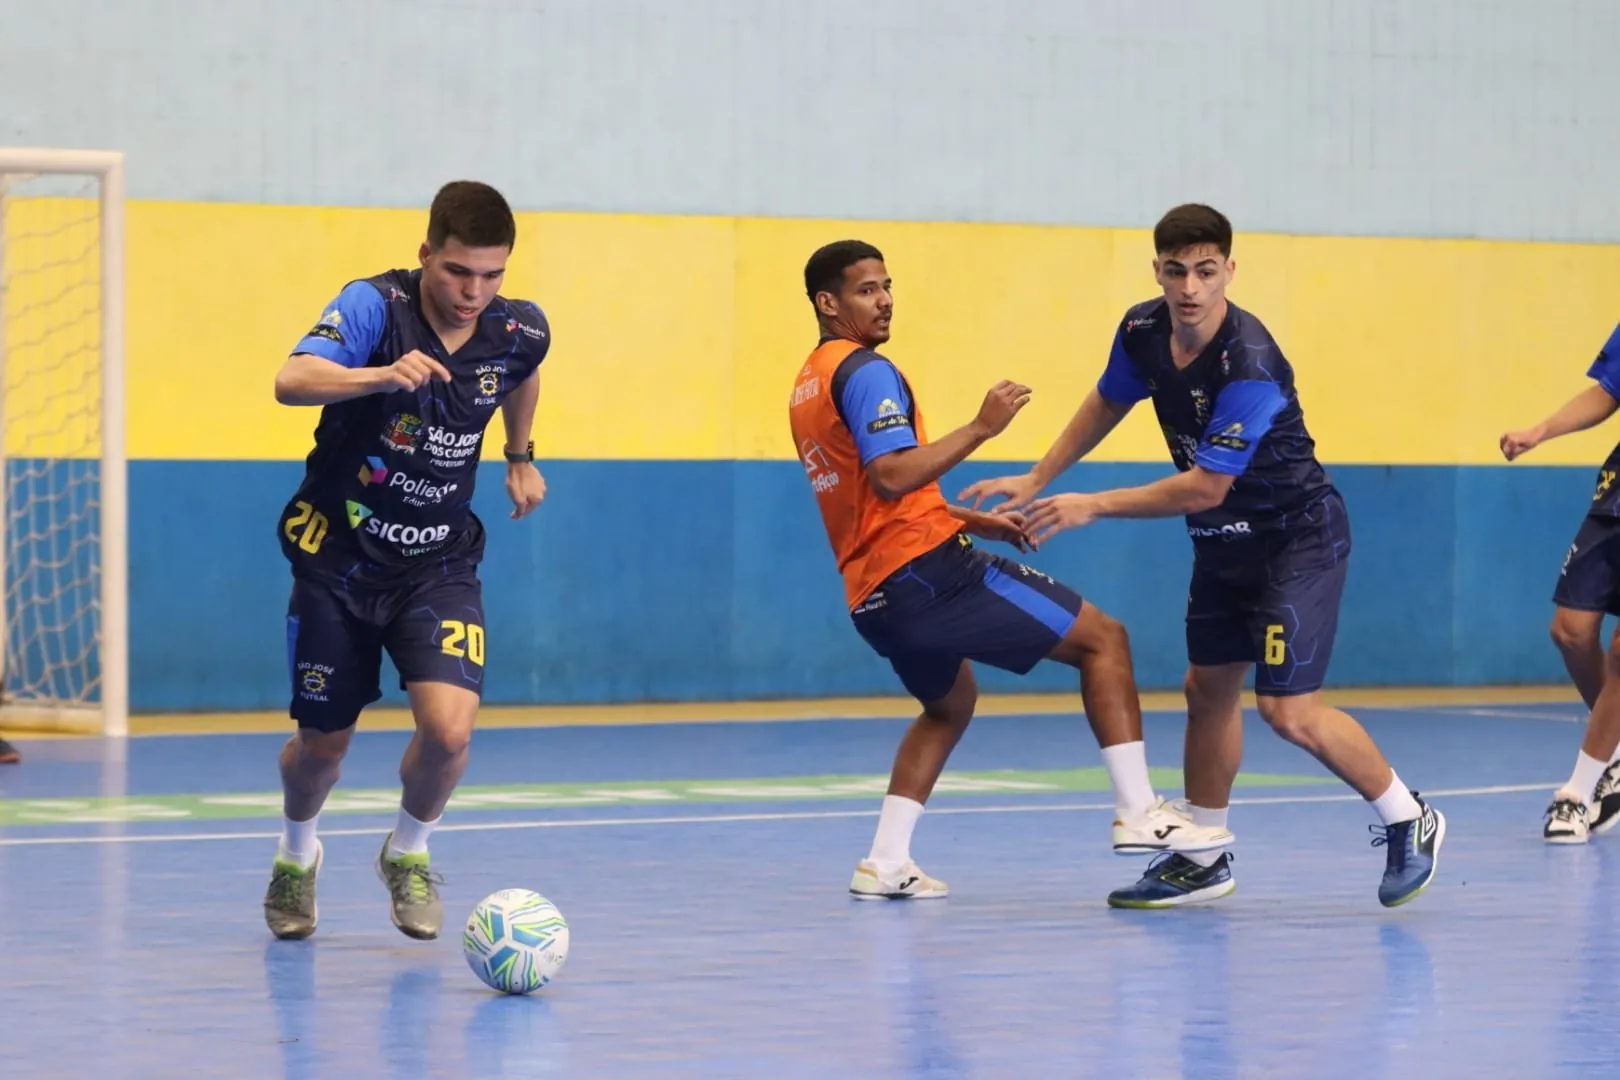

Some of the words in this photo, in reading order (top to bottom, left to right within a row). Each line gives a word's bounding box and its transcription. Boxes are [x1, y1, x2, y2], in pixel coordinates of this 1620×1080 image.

[423, 442, 444, 457] DOS
[428, 426, 456, 446] SÃO
[285, 500, 329, 555] 20
[365, 517, 451, 545] SICOOB
[440, 619, 485, 667] 20
[1265, 624, 1285, 666] 6
